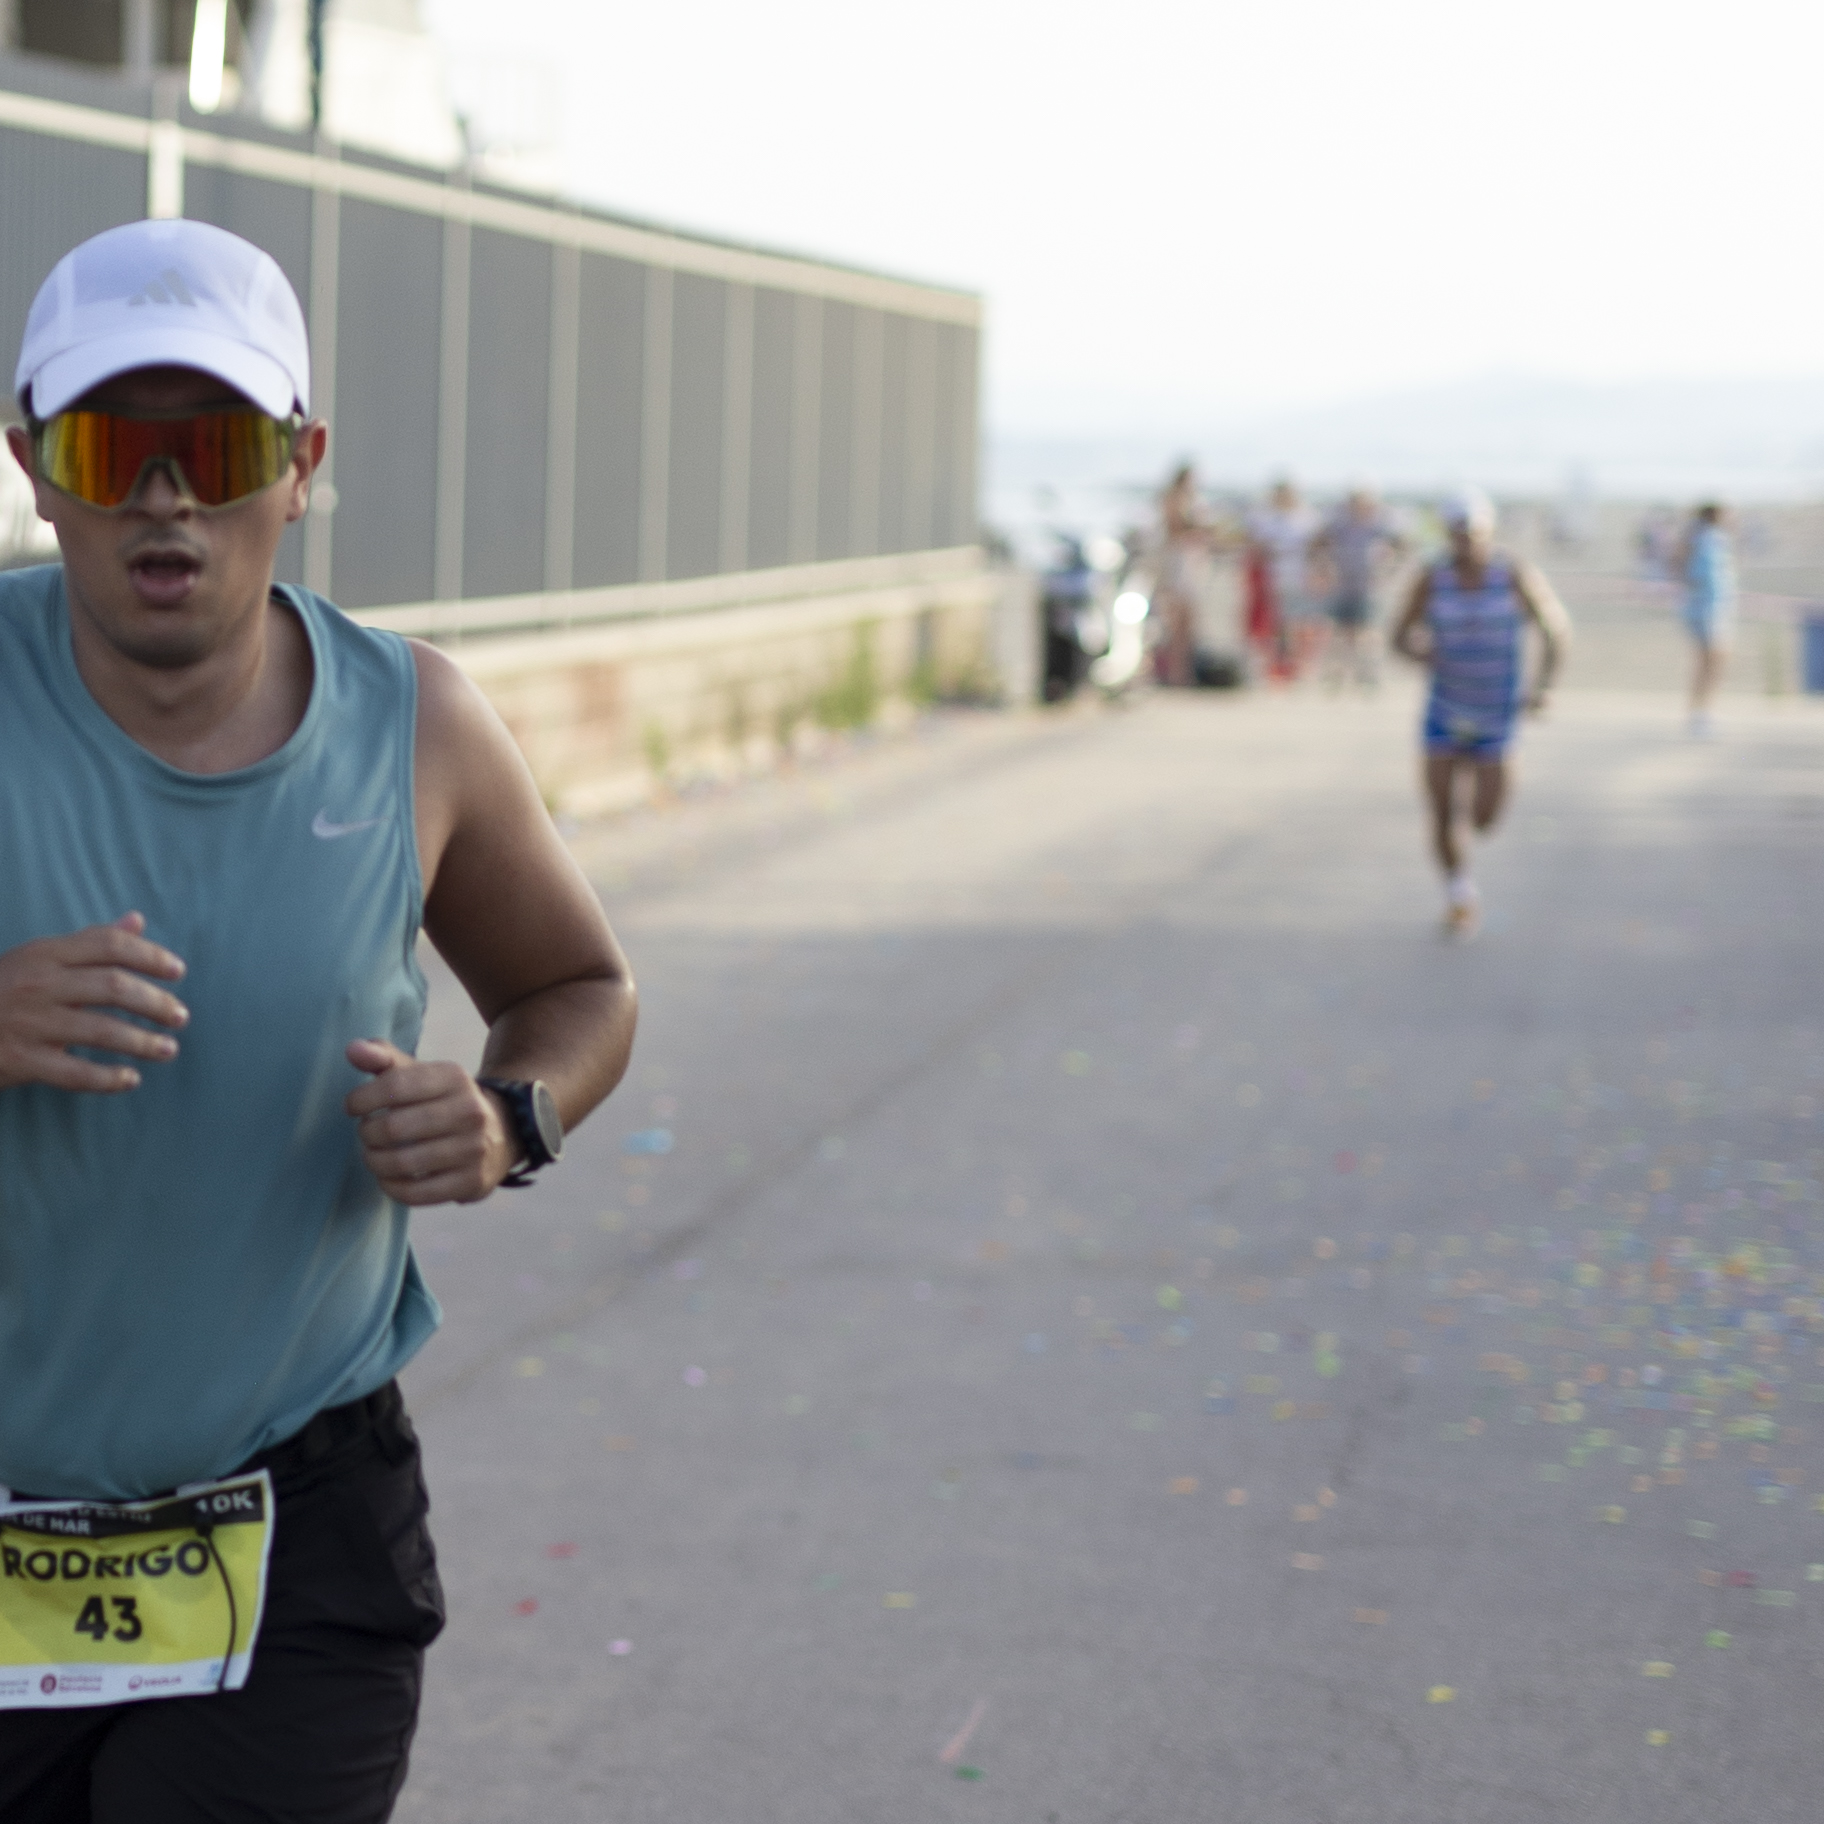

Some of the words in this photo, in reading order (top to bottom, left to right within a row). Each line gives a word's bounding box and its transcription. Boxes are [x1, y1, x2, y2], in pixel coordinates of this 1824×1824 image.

[195, 1489, 254, 1514] 10K
[2, 1540, 210, 1582] RODRIGO
[74, 1594, 143, 1643] 43
